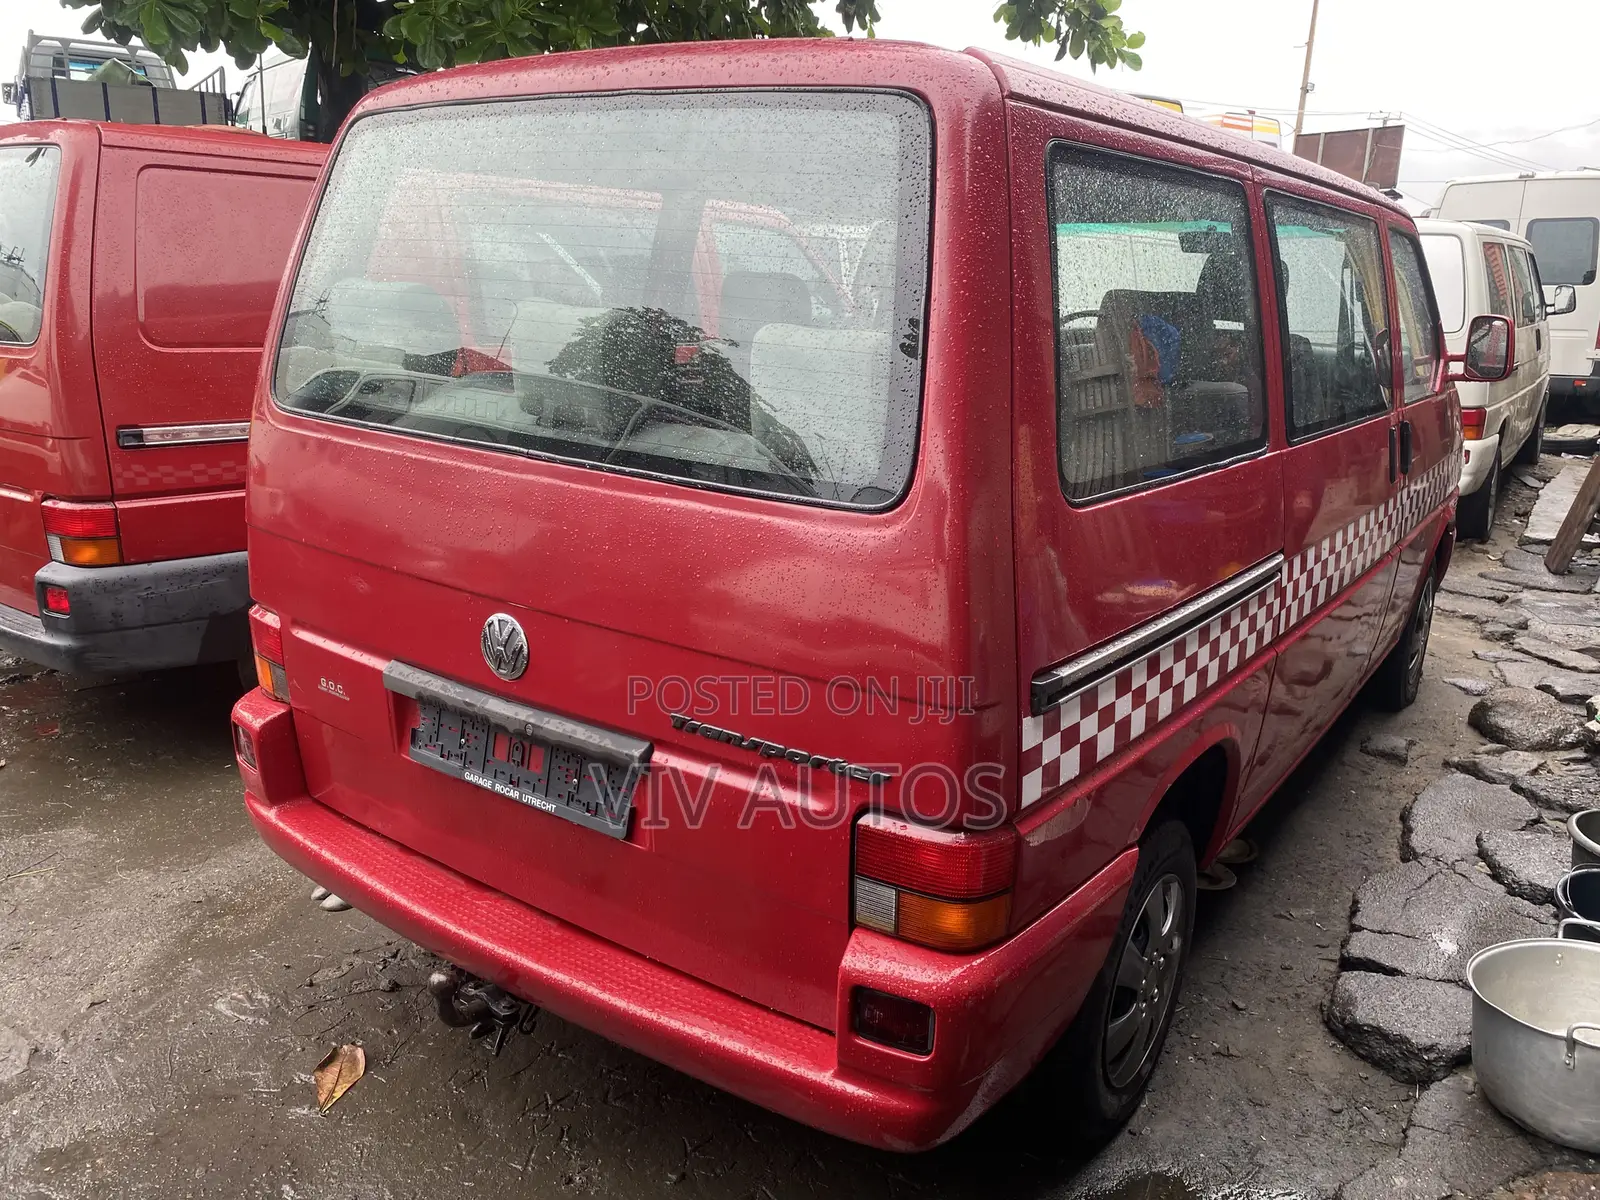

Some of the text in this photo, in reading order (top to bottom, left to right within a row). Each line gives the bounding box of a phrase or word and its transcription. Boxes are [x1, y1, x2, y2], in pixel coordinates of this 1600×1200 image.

[669, 712, 893, 786] Transporter
[464, 771, 557, 813] GARAGE ROCAR UTRECHT
